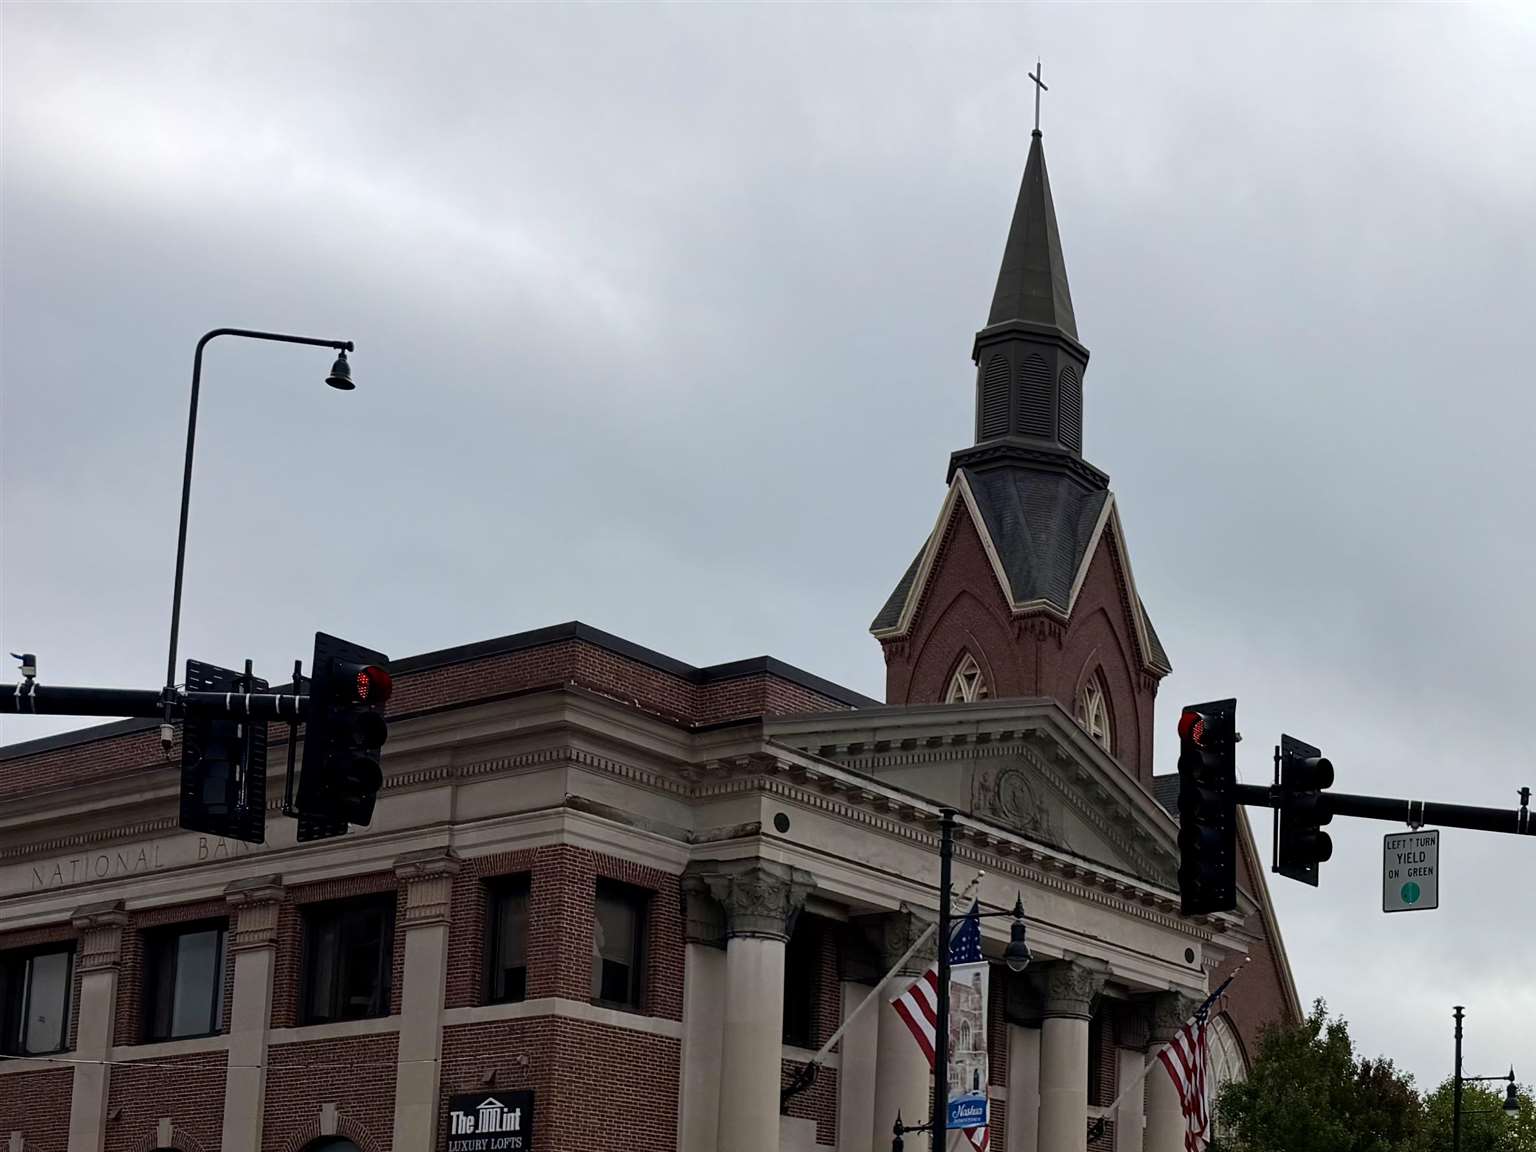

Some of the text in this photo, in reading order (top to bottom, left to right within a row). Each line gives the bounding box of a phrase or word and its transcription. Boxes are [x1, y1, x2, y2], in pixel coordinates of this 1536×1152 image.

[1387, 837, 1436, 850] LEFT TURN
[31, 836, 272, 889] NATIONAL BAN
[1397, 851, 1426, 864] YIELD
[1388, 866, 1434, 879] ON GREEN
[450, 1104, 521, 1135] The Mint
[448, 1136, 522, 1152] LUXURY LOFTS
